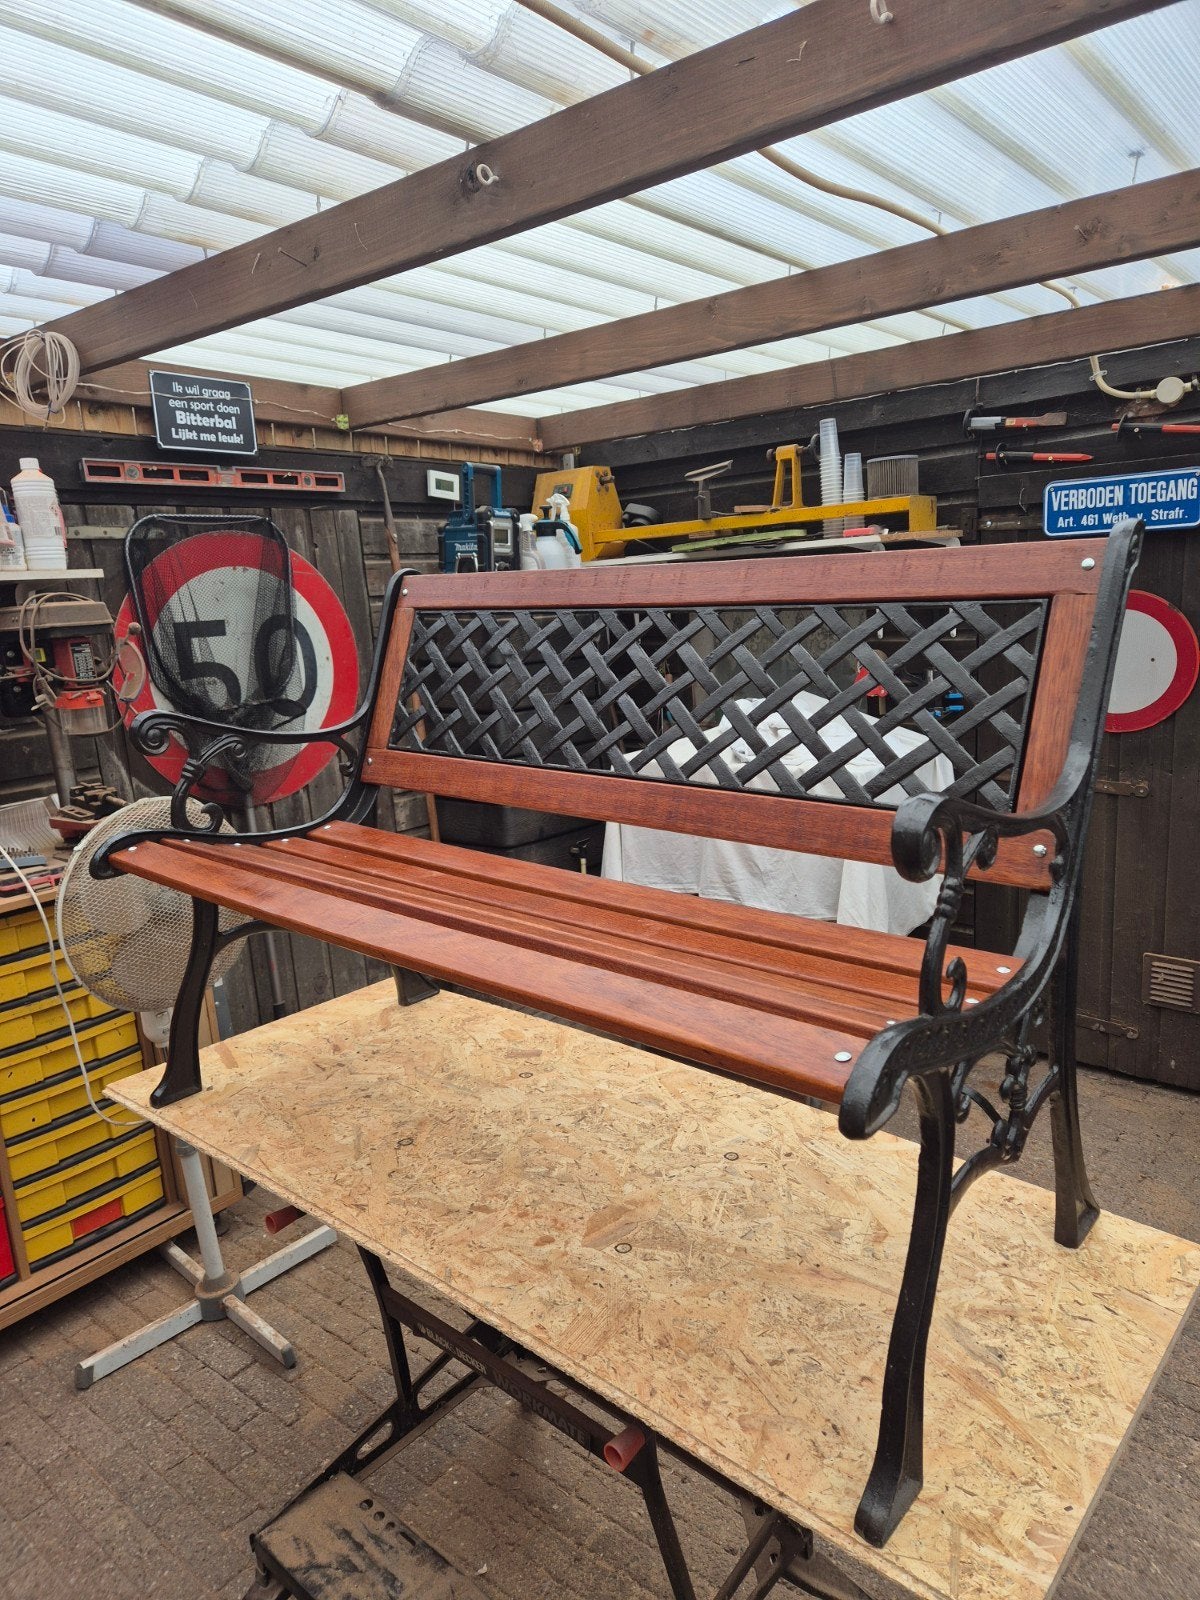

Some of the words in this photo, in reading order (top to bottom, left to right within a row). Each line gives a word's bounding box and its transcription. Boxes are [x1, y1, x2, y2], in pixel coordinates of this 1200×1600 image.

[172, 382, 183, 393] Ik
[185, 385, 200, 395] wil
[202, 388, 231, 400] graag
[168, 399, 188, 409] een
[190, 401, 214, 411] sport
[216, 403, 241, 414] doen
[175, 410, 237, 429] Bitterbal
[171, 428, 198, 440] Lijkt
[200, 433, 216, 442] me
[218, 432, 244, 444] leuk!
[1051, 485, 1124, 512] VERBODEN
[1129, 478, 1198, 505] TOEGANG
[1057, 516, 1077, 528] Art.
[1081, 513, 1098, 526] 461
[1151, 507, 1188, 521] Strafr.
[173, 614, 317, 717] 50
[493, 1369, 585, 1442] WORKMATE
